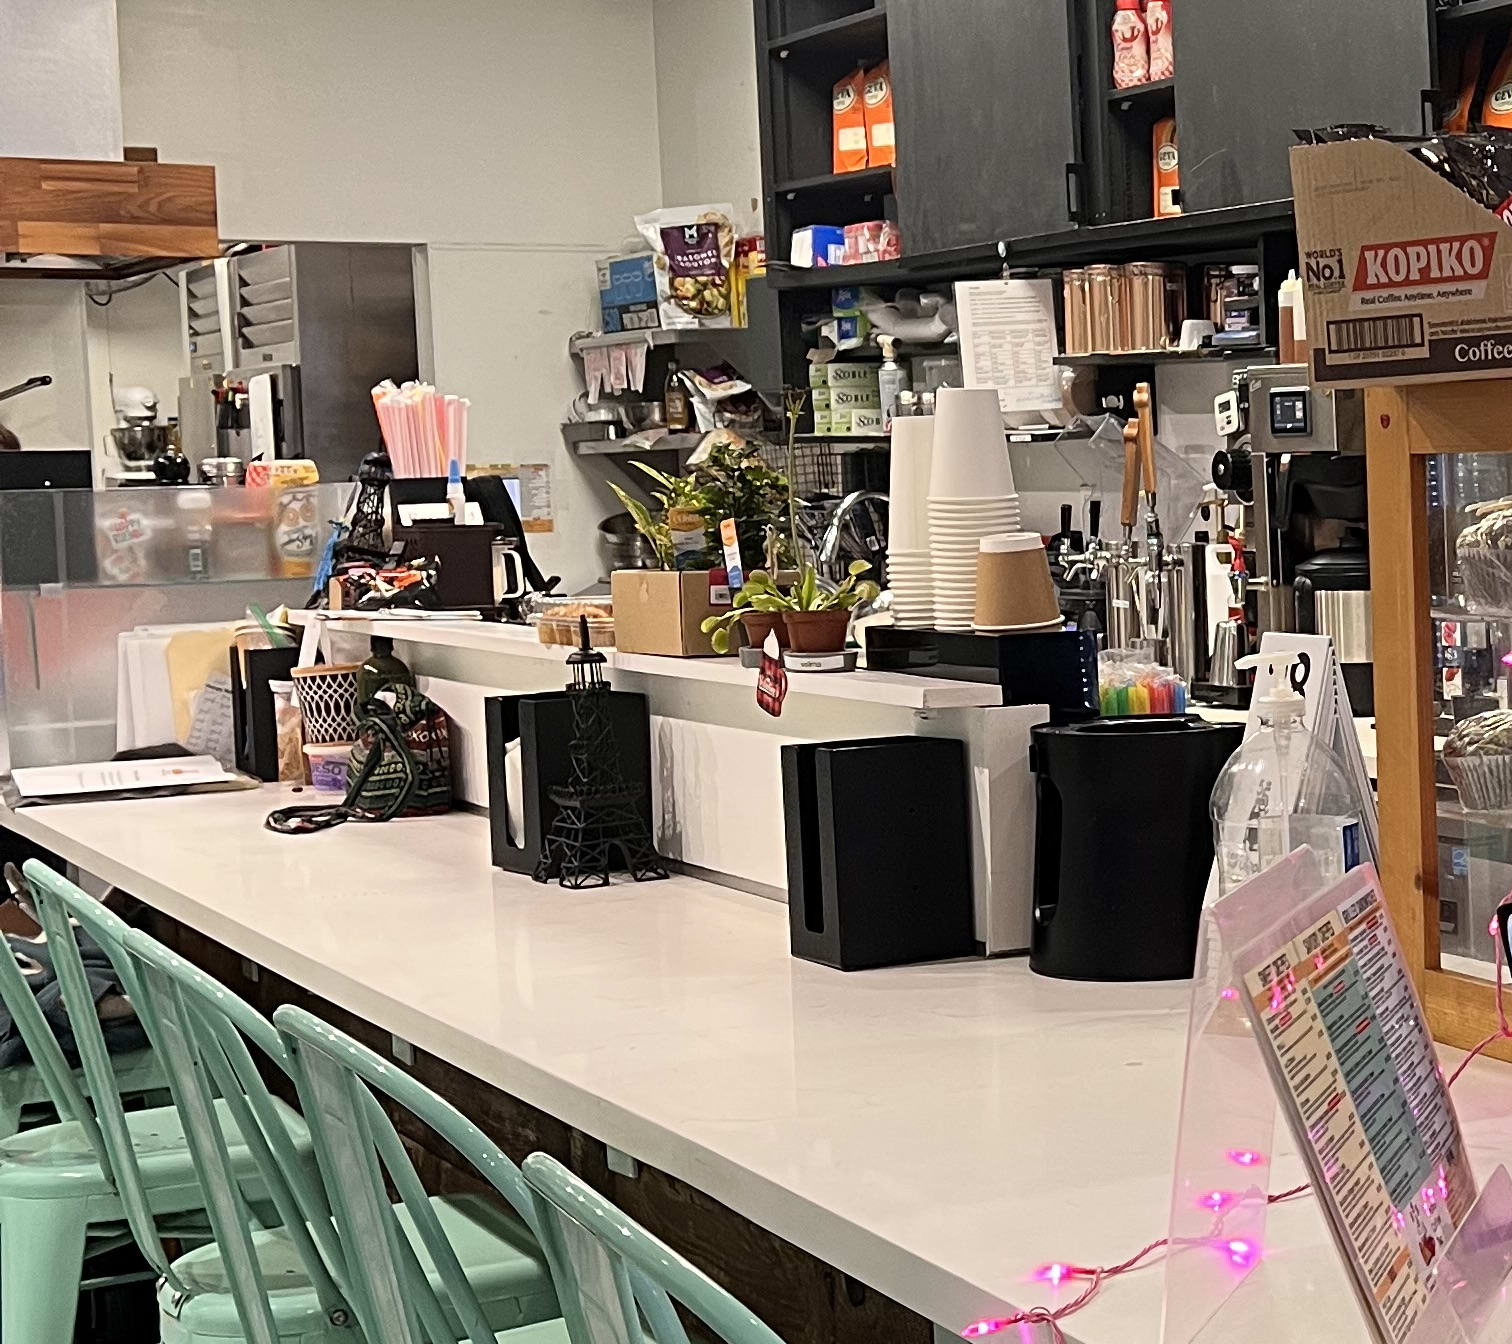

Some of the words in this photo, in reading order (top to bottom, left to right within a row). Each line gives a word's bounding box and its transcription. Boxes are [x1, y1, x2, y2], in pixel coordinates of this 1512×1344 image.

[1304, 247, 1343, 260] WORLD'S
[1363, 240, 1485, 285] KOPIKO
[1305, 258, 1347, 283] No.1
[1360, 297, 1378, 306] Real
[1436, 287, 1473, 300] Anywhere
